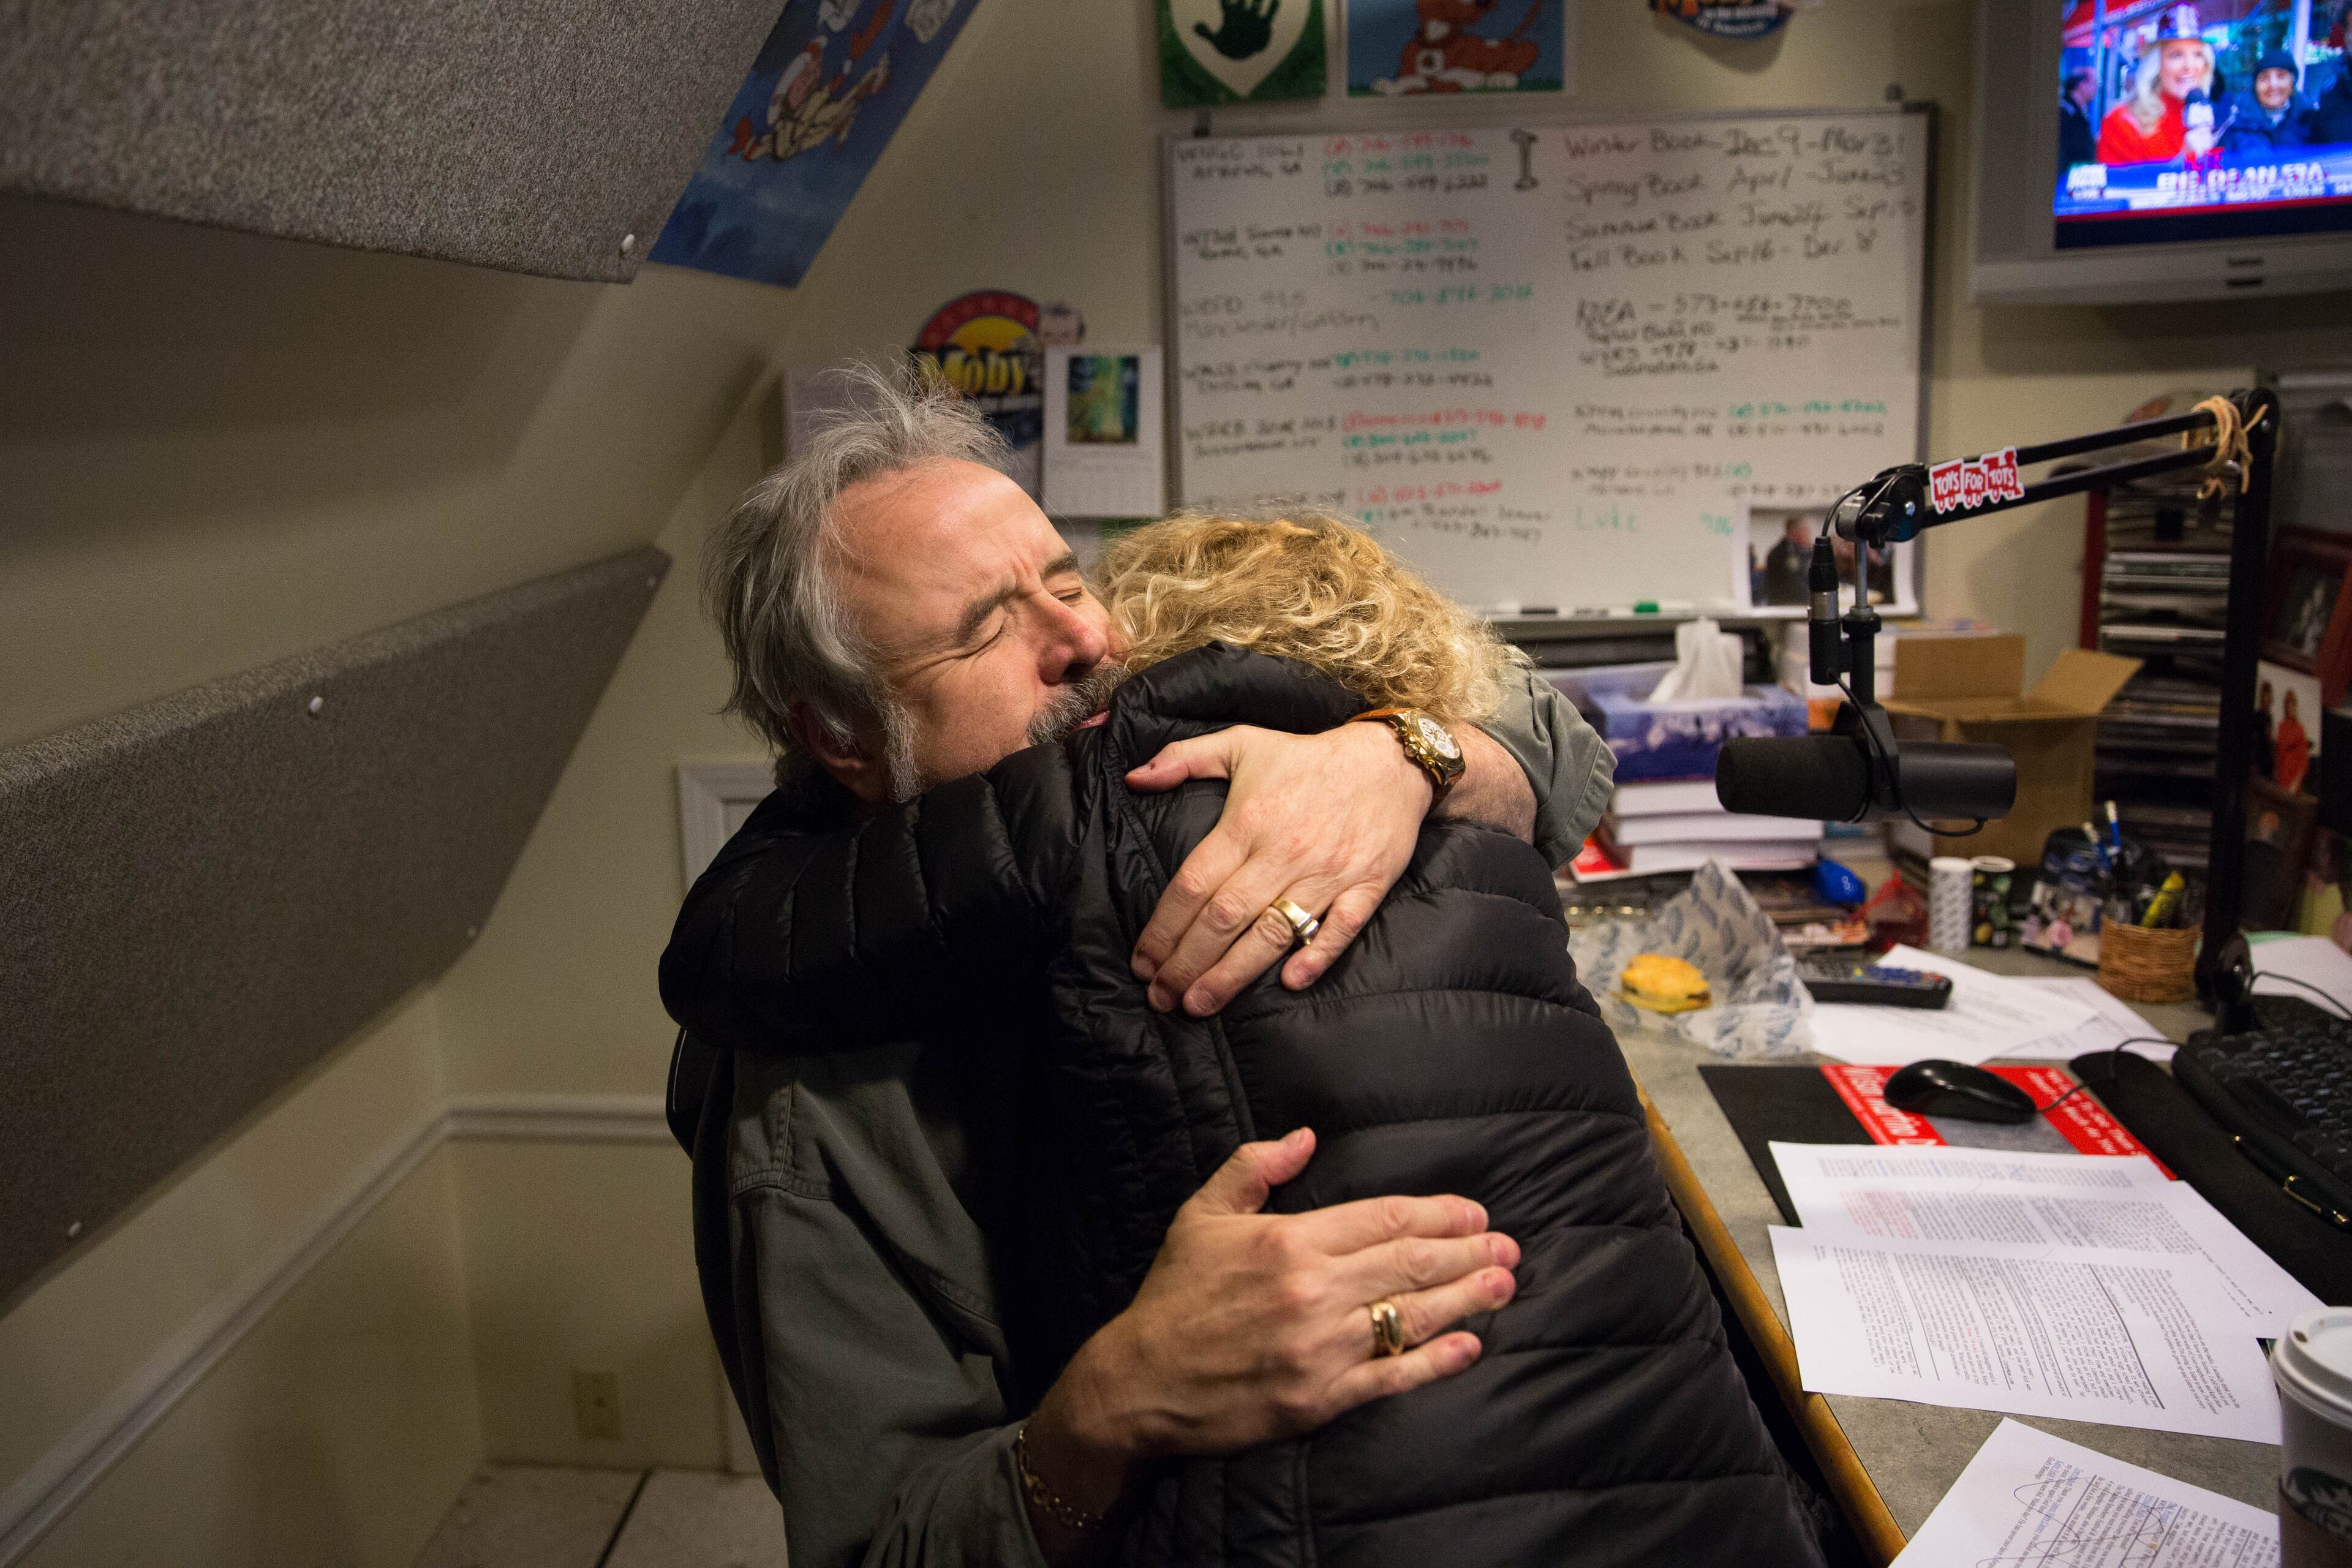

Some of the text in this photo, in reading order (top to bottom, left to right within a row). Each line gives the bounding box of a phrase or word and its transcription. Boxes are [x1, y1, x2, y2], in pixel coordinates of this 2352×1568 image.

[1935, 467, 2015, 496] TOYS FOR TOTS
